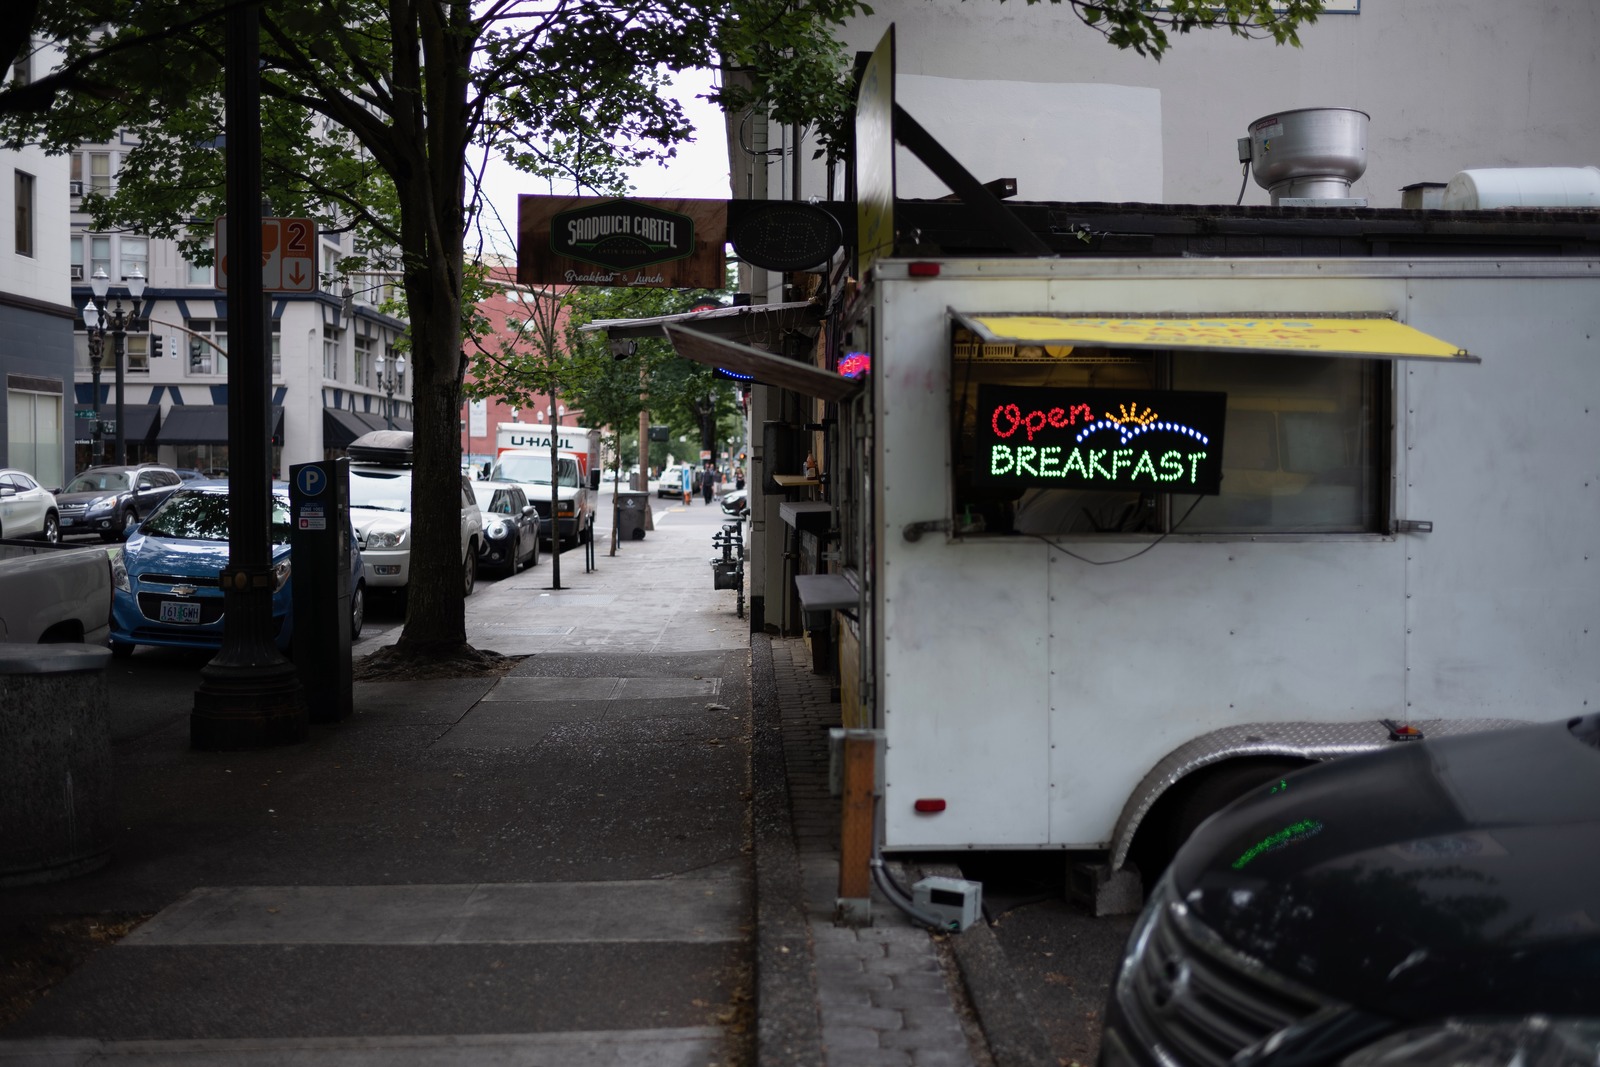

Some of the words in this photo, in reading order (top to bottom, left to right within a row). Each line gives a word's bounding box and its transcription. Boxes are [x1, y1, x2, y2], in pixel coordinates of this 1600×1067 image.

[287, 222, 306, 251] 2
[567, 215, 632, 246] SANDWICH
[633, 216, 677, 248] CARTEL
[738, 222, 829, 253] OPEN
[564, 269, 621, 283] Breakfast
[627, 271, 664, 285] Lunch
[992, 403, 1095, 441] Open
[511, 436, 573, 449] U-HAUL
[991, 445, 1207, 484] BREAKFAST
[306, 470, 319, 491] P
[163, 606, 177, 617] 161
[183, 607, 199, 619] GWH
